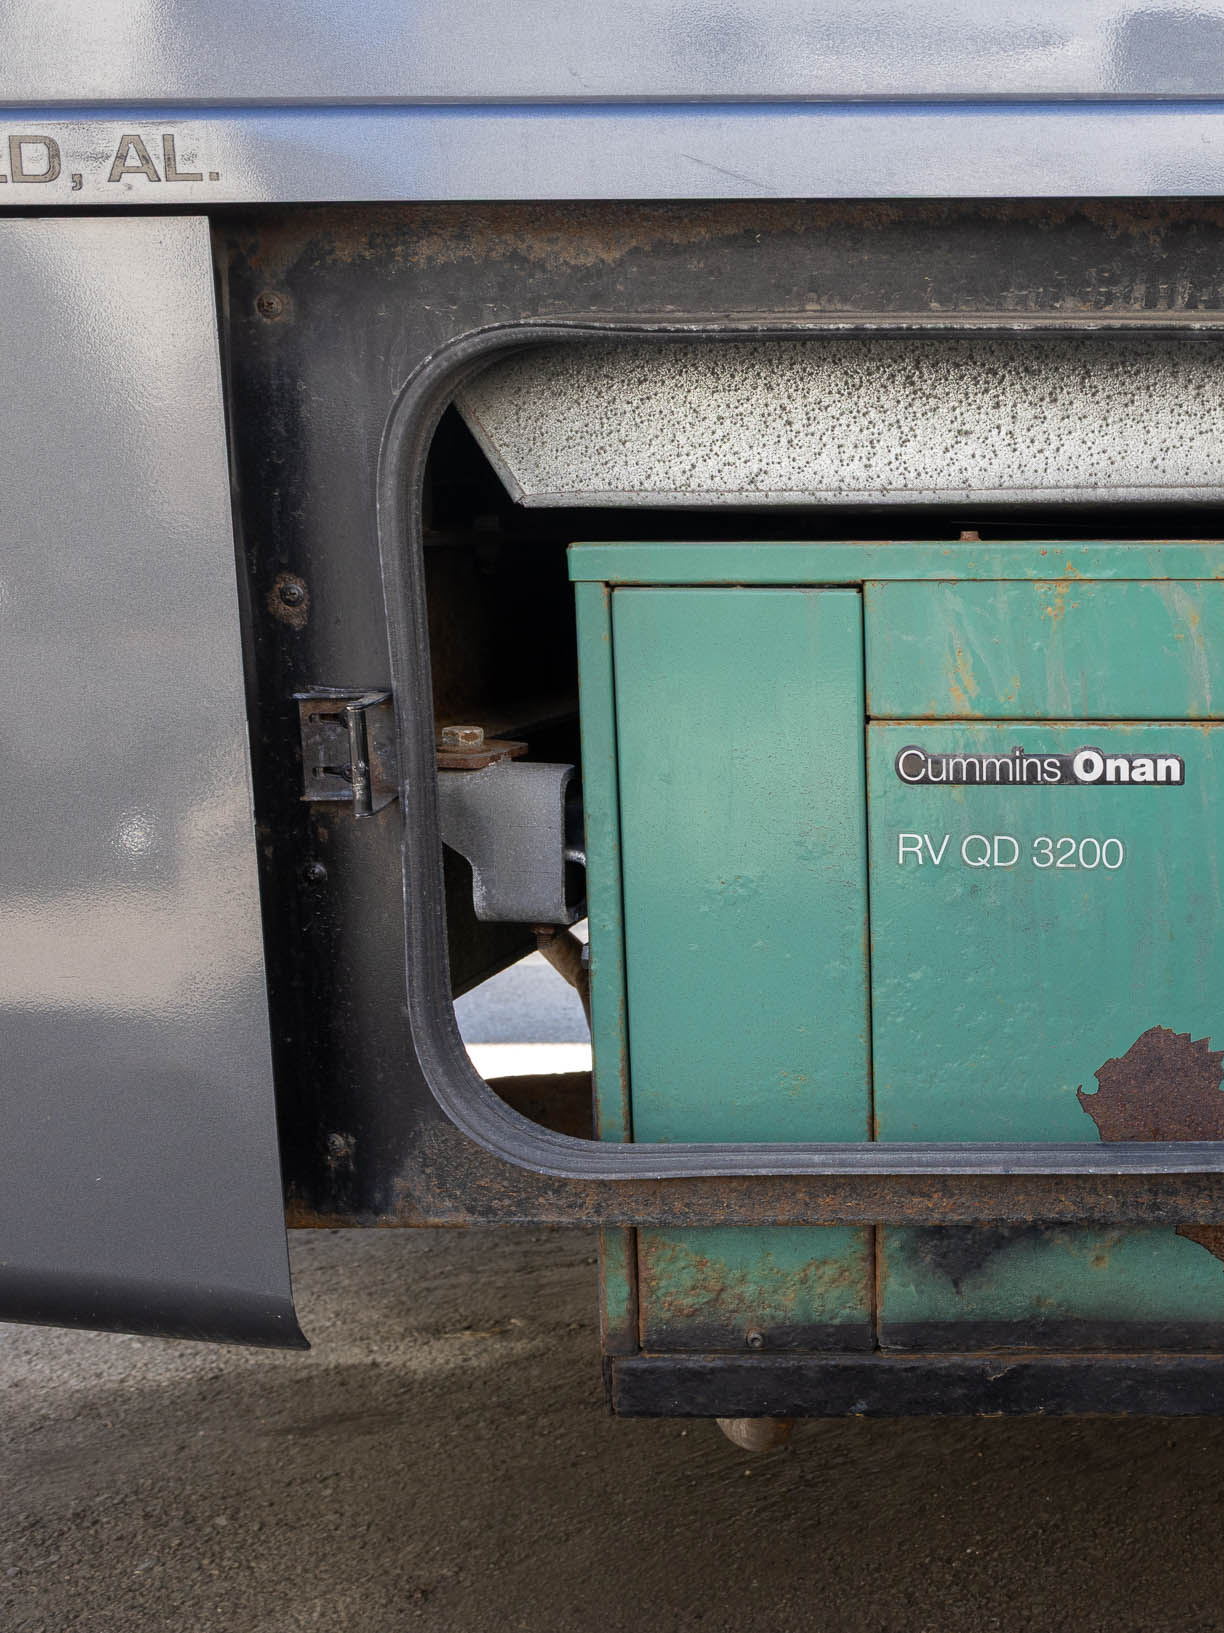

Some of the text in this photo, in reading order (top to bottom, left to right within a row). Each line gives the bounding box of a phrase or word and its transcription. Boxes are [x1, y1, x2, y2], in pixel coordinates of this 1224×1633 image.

[0, 133, 220, 191] D, AL.
[898, 750, 1182, 782] Cummins Onan
[898, 833, 1124, 869] RV QD 3200
